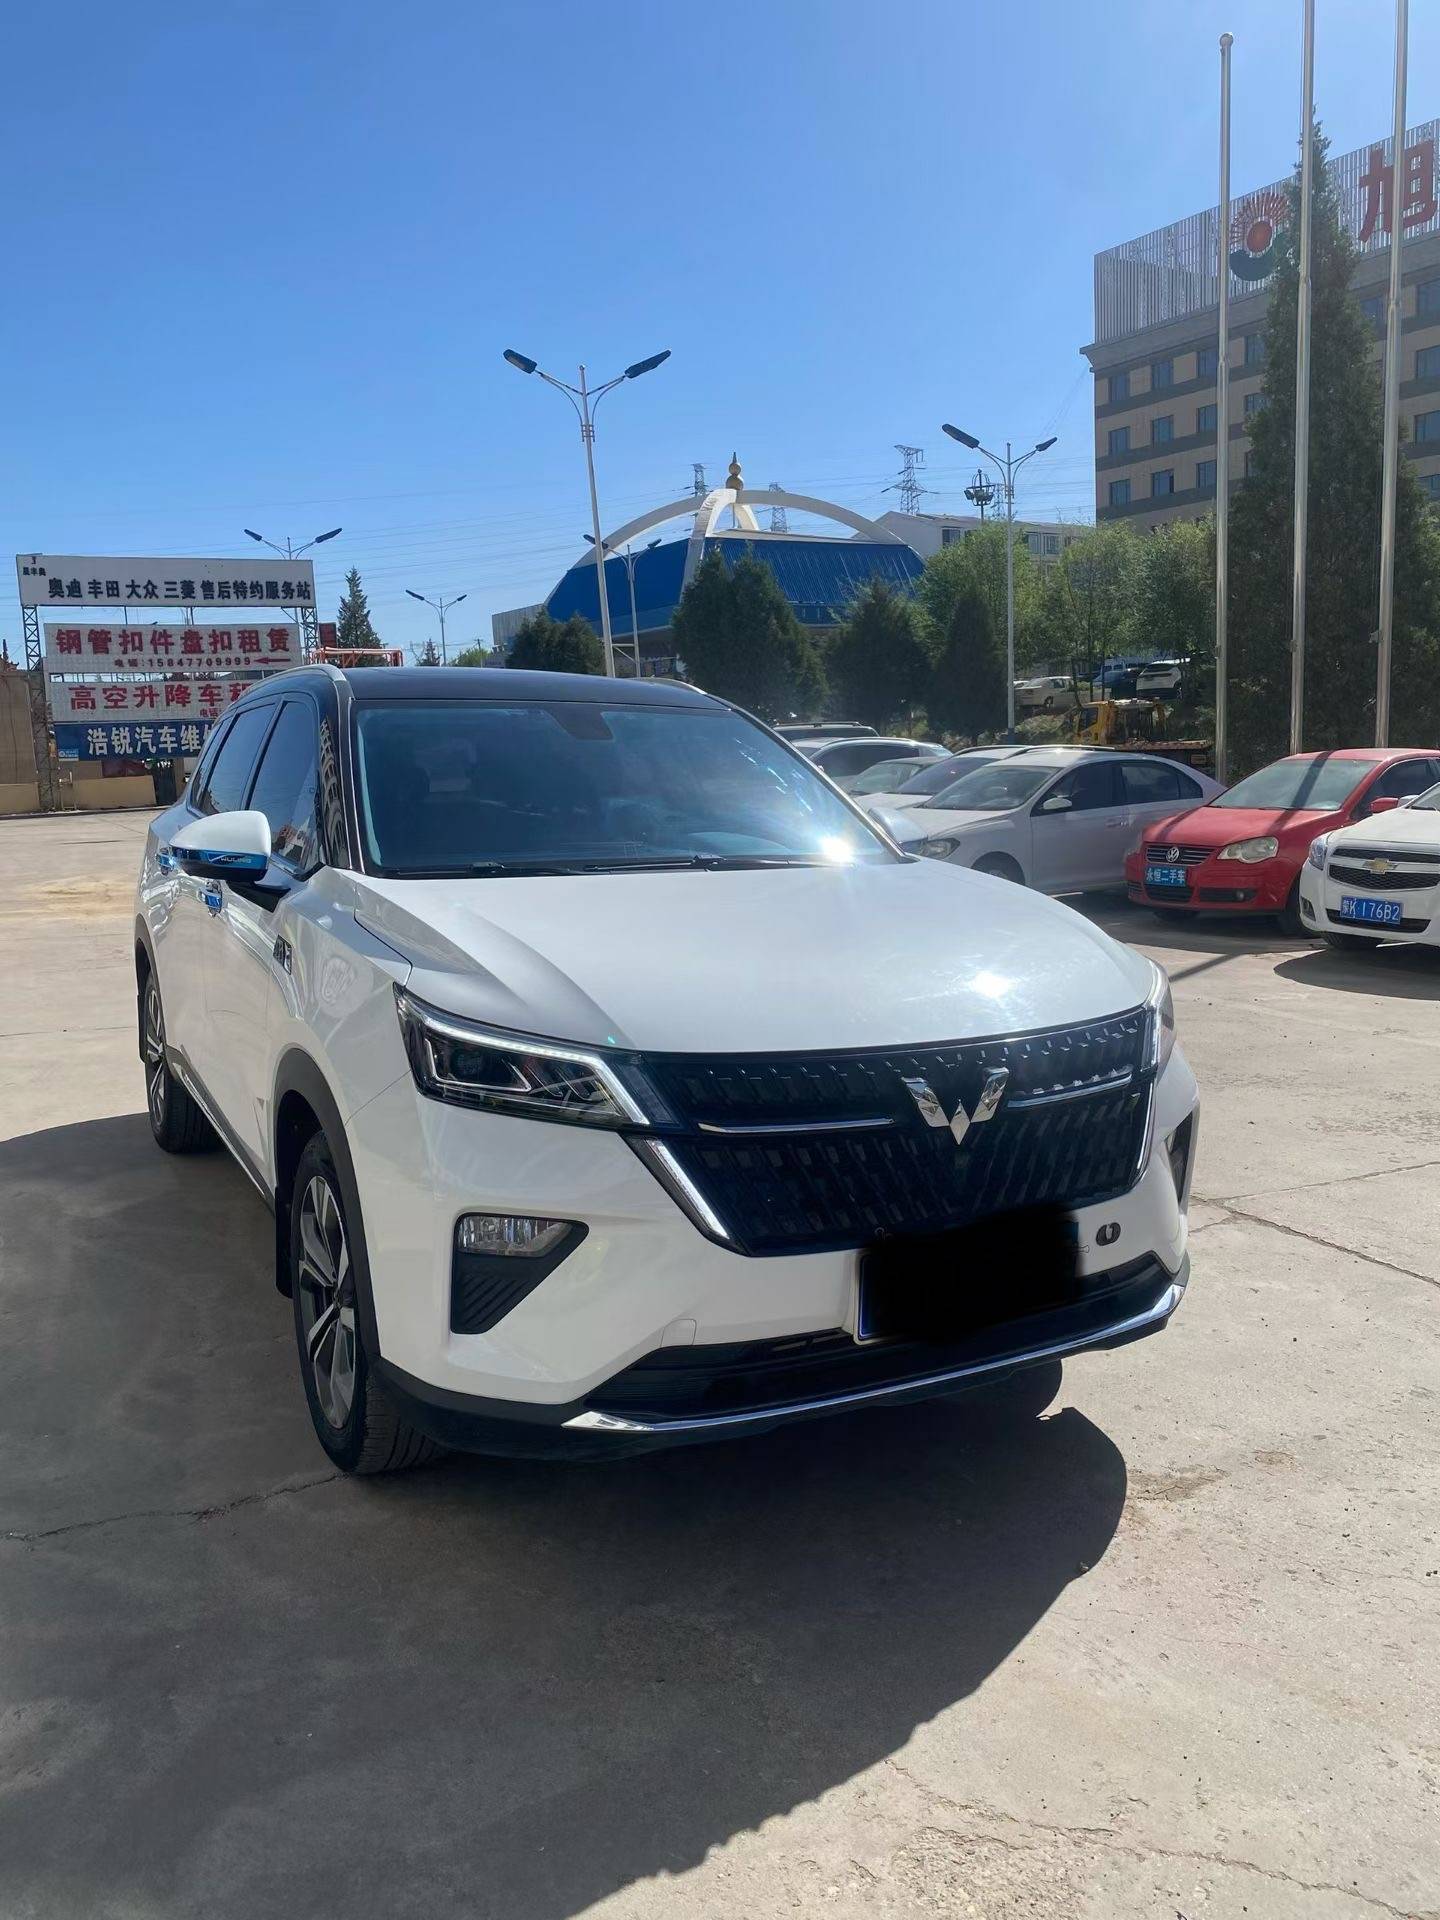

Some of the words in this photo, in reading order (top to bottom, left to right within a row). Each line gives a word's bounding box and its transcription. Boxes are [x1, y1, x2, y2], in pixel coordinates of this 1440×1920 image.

[56, 628, 290, 655] 钢管扣件盘扣租赁
[87, 724, 213, 756] 浩锐汽车维
[1146, 867, 1186, 884] 永恒二手车
